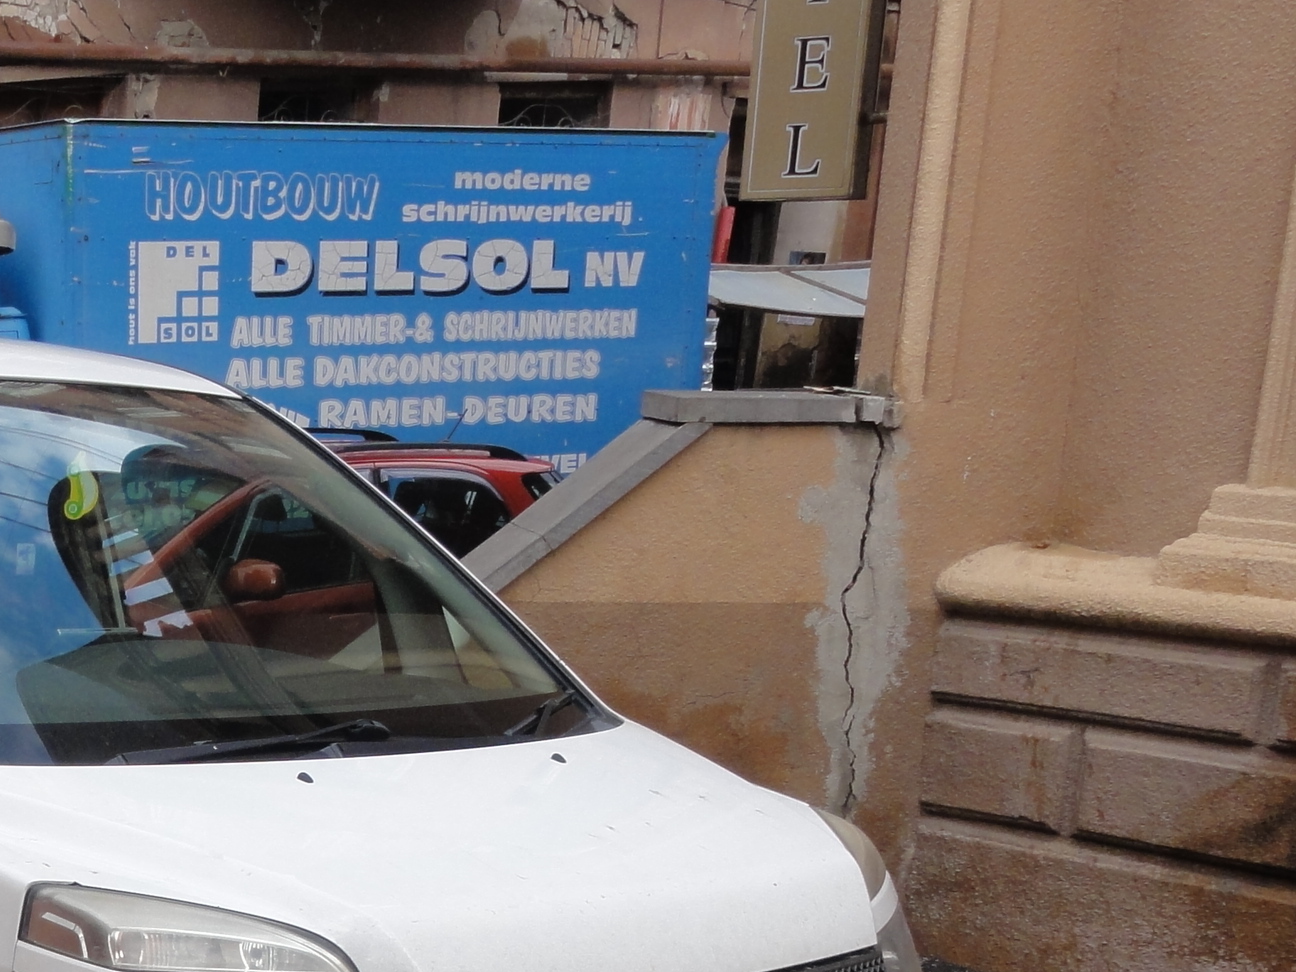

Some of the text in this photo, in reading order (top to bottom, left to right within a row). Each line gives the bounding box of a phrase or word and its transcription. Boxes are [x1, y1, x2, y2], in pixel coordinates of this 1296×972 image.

[781, 0, 832, 178] EL
[145, 171, 380, 221] HOUTBOUW
[454, 169, 592, 191] moderne
[402, 201, 633, 225] schrijnwerkerij
[166, 245, 211, 258] DEL
[251, 239, 645, 297] DELSOL NV
[128, 297, 136, 310] is
[128, 313, 136, 345] hout
[163, 325, 213, 340] SOL
[230, 315, 293, 348] ALLE
[443, 308, 638, 342] SCHRIJNWERKEN
[225, 348, 601, 389] ALLE DAKCONSTRUCTIES
[318, 392, 599, 429] RAMEN-DEUREN
